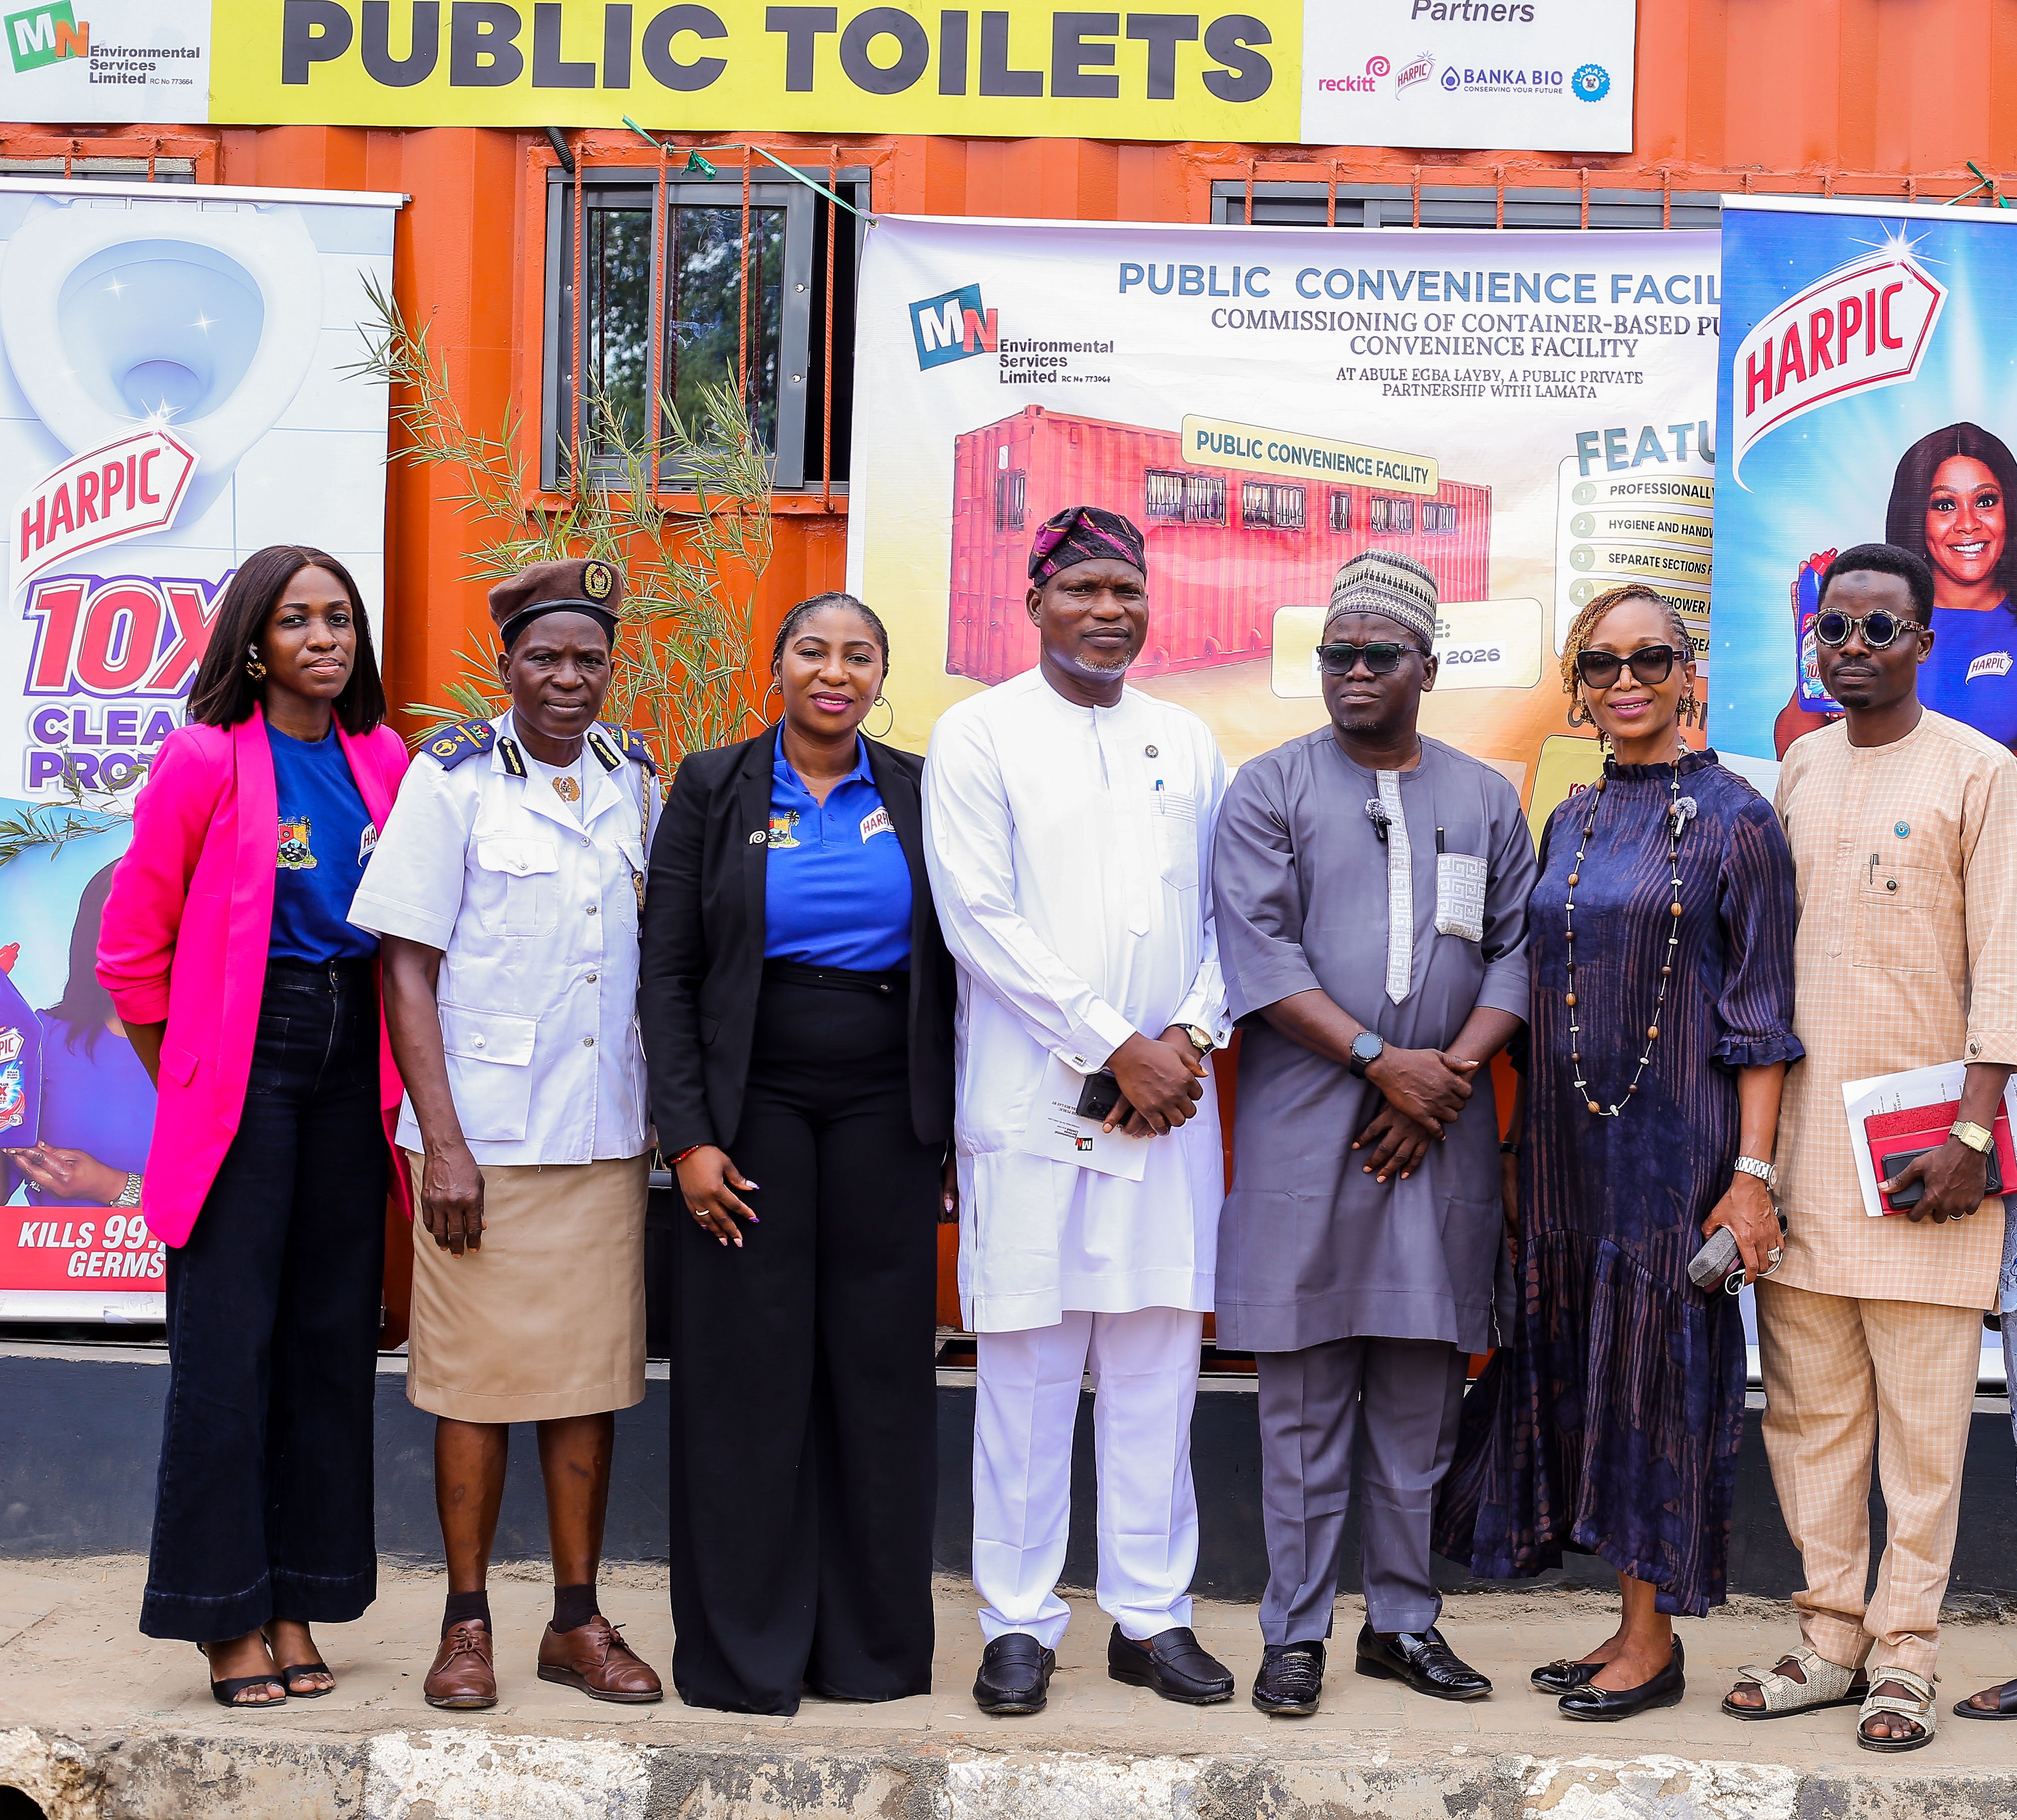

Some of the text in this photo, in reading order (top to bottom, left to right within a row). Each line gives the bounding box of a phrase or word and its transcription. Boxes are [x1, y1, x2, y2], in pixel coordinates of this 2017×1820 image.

[1411, 0, 1535, 22] Partners
[90, 45, 200, 58] Environmental
[280, 0, 1273, 102] PUBLIC TOILETS
[89, 58, 157, 71] Services
[89, 72, 147, 84] Limited
[1318, 74, 1376, 92] reckitt
[1397, 63, 1427, 87] HARPIC
[1464, 69, 1563, 85] BANKA BIO
[1575, 67, 1607, 83] LAMATA
[1119, 262, 1271, 298] PUBLIC
[1295, 267, 1597, 304] CONVENIENCE
[918, 298, 998, 353] MN
[1211, 308, 1418, 332] COMMISSIONING
[1424, 313, 1456, 332] OF
[1462, 313, 1691, 335] CONTAINER-BASED
[1000, 338, 1114, 354] Environmental
[1350, 335, 1639, 358] CONVENIENCE FACILITY
[1746, 280, 1903, 418] HARPIC
[999, 354, 1068, 368] Services
[1000, 370, 1057, 384] Limited
[1336, 367, 1644, 385] AT ABULE EGBA LAYBY, A PUBLIC PRIVATE
[1382, 383, 1597, 398] PARTNERSHIP WITH LAMATA
[1197, 430, 1429, 484] PUBLIC CONVENIENCE FACILITY
[1581, 488, 1586, 499] 1
[21, 447, 161, 563] HARPIC
[1578, 519, 1586, 531] 2
[1609, 519, 1655, 531] HYGIENE
[1657, 521, 1679, 533] AND
[1577, 552, 1585, 563] 3
[1608, 553, 1661, 568] SEPARATE
[1662, 558, 1707, 574] SECTIONS
[1577, 586, 1585, 599] 4
[1446, 648, 1501, 665] 2026
[1807, 663, 1821, 678] 10
[1971, 658, 2005, 673] HARPIC
[18, 1222, 96, 1249] KILLS
[67, 1251, 167, 1278] GERMS
